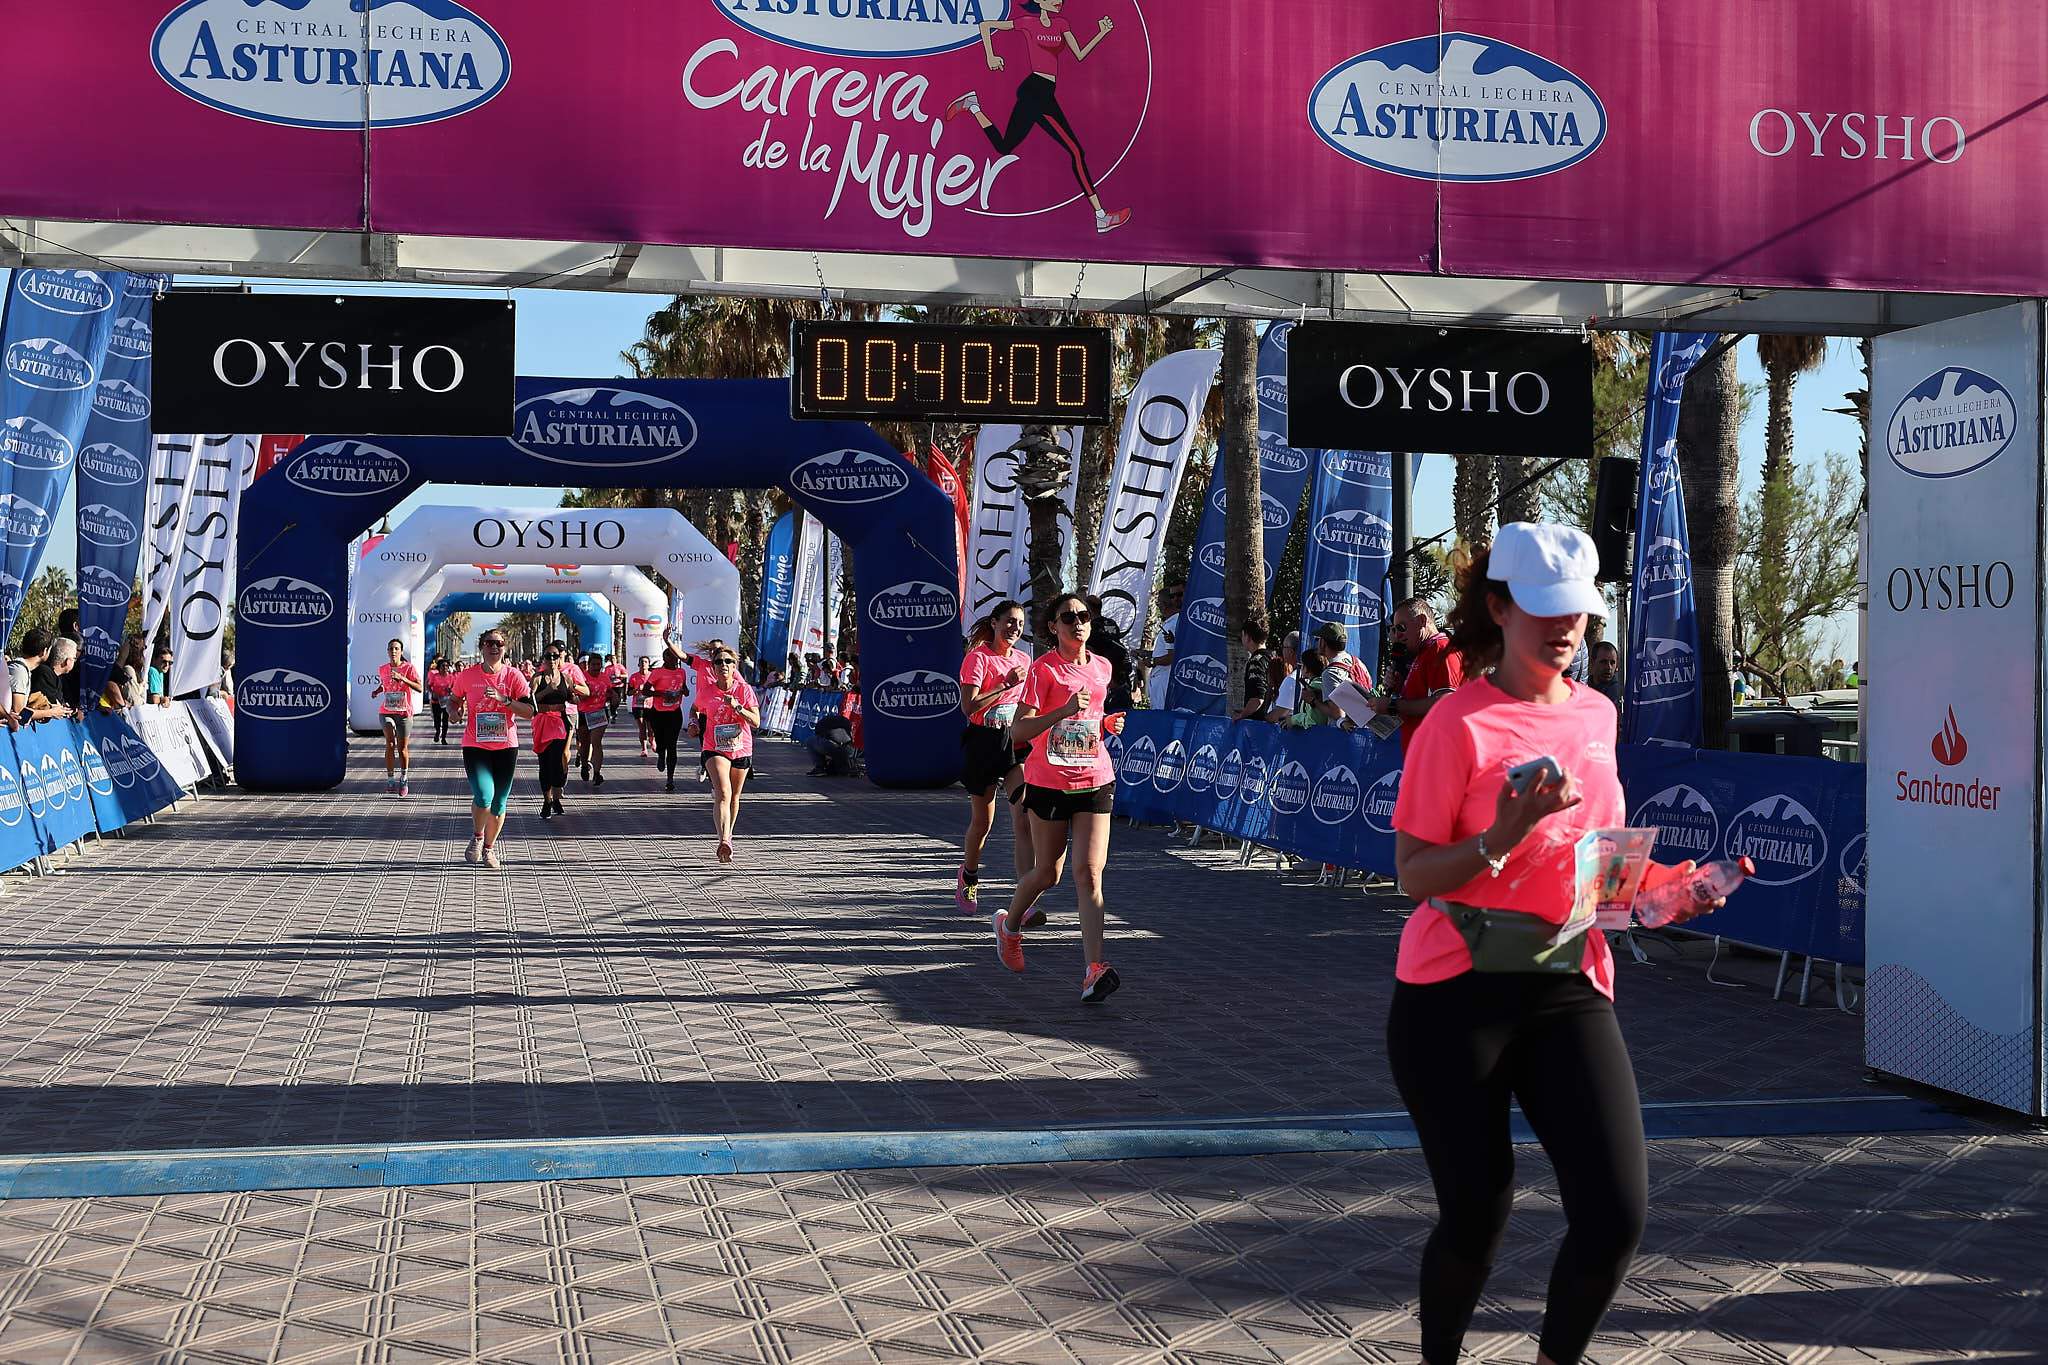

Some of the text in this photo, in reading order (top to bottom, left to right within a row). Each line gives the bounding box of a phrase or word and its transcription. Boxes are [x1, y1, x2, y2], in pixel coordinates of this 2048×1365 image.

[732, 0, 984, 25] URIANA
[236, 19, 472, 43] CENTRAL LECHERA
[1036, 34, 1062, 42] OYSHO
[179, 20, 484, 90] ASTURIANA
[682, 39, 929, 122] Carrera
[1379, 82, 1574, 103] CENTRAL LECHERA
[1332, 82, 1584, 146] ASTURIANA
[1750, 108, 1967, 165] OYSHO
[742, 117, 1020, 238] de la Mujer
[24, 272, 104, 308] ASTURIANA
[41, 274, 73, 286] CENTRAL
[9, 350, 85, 386] ASTURIANA
[213, 338, 464, 393] OYSHO
[815, 337, 1087, 407] 00:40:00
[1338, 364, 1550, 416] OYSHO
[549, 409, 677, 421] CENTRAL LECHERA
[1914, 397, 2002, 421] CENTRAL LECHERA
[518, 410, 684, 447] ASTURIANA
[1895, 413, 2007, 456] ASTURIANA
[3, 438, 65, 464] STURIANA
[357, 459, 399, 467] LECHERA
[1259, 447, 1301, 469] URIANA
[83, 452, 138, 480] ASTURIANA
[292, 459, 400, 482] ASTURIANA
[816, 467, 854, 475] CENTRAL
[1328, 453, 1392, 479] ASTURIA
[800, 470, 902, 491] ASTURIANA
[80, 513, 131, 541] ASTURIANA
[181, 435, 232, 641] OYSH
[472, 518, 626, 550] OYSHO
[974, 451, 1021, 613] YSHO
[380, 551, 427, 564] OYSHO
[668, 552, 713, 564] OYSHO
[253, 592, 325, 601] CENTRAL LECHERA
[767, 555, 792, 622] Marlene
[1887, 561, 2014, 612] OYSHO
[242, 594, 328, 616] ASTURIANA
[359, 611, 402, 625] OYSHO
[875, 602, 954, 620] ASTURIANA
[1189, 604, 1227, 629] ASTUR
[1311, 595, 1380, 621] ASTURIANA
[691, 614, 733, 626] OYSHO
[287, 685, 322, 693] LECHERA
[357, 674, 381, 686] OYS
[1177, 663, 1227, 690] ASTURIAN
[240, 686, 324, 708] ASTURIANA
[878, 690, 957, 708] ASTURIANA
[1313, 784, 1355, 811] ASTURIANA
[1896, 770, 2001, 810] Santander
[1365, 791, 1396, 817] ASTUR
[1651, 812, 1712, 825] CENTRAL LECHERA
[1747, 823, 1815, 840] CENTRAL LECHERA
[1730, 823, 1814, 867] ASTURIANA
